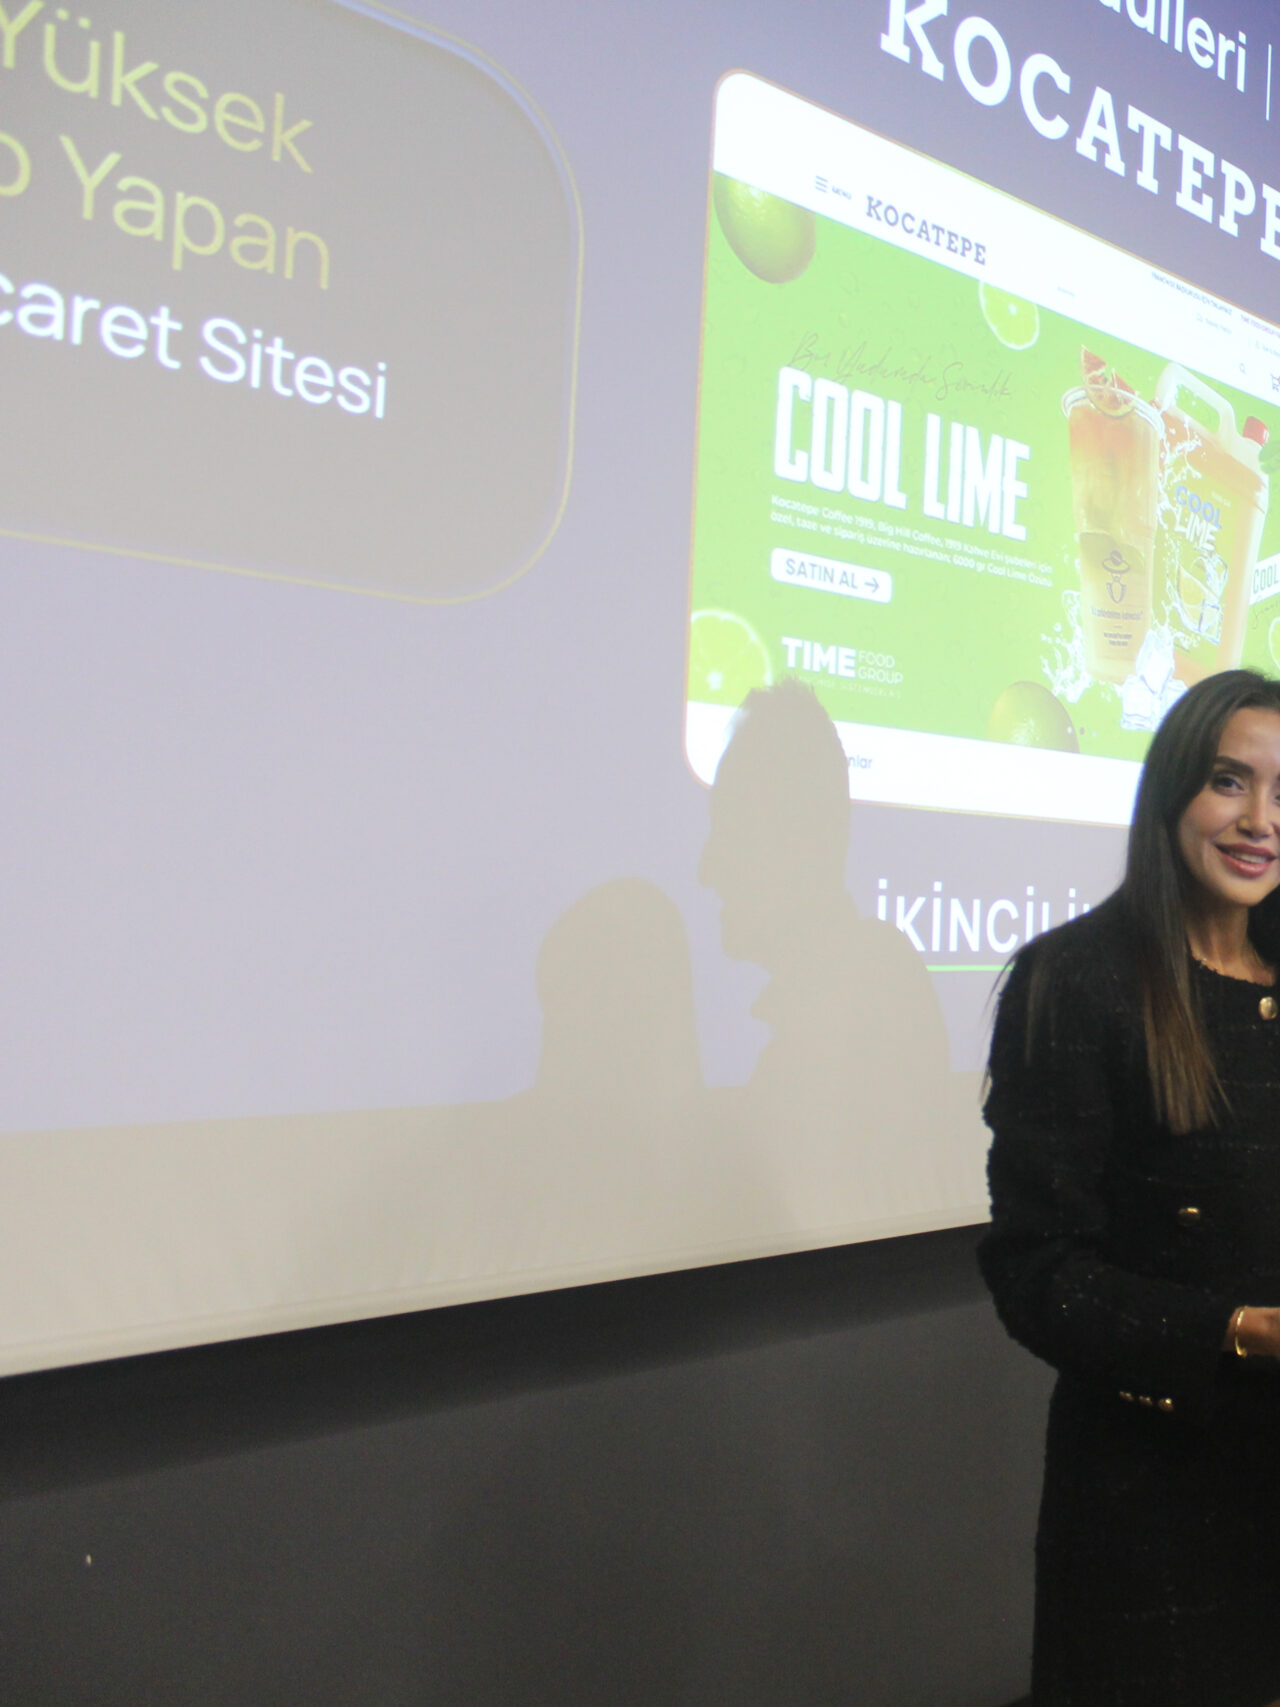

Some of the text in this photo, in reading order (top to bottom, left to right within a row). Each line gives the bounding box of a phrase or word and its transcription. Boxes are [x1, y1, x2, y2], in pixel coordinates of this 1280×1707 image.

[1101, 0, 1246, 92] lleri
[0, 0, 313, 174] Yüksek
[59, 134, 330, 289] Yapan
[866, 195, 987, 266] KOCATEPE
[199, 317, 388, 419] Sitesi
[774, 366, 1031, 541] COOL LIME
[821, 507, 854, 524] Coffee
[1175, 485, 1222, 530] COOL
[785, 558, 858, 589] SATIN AL
[987, 563, 1006, 576] Cool
[1252, 568, 1280, 595] COOL
[781, 636, 896, 679] TIME FOOD
[858, 666, 903, 685] GROUP
